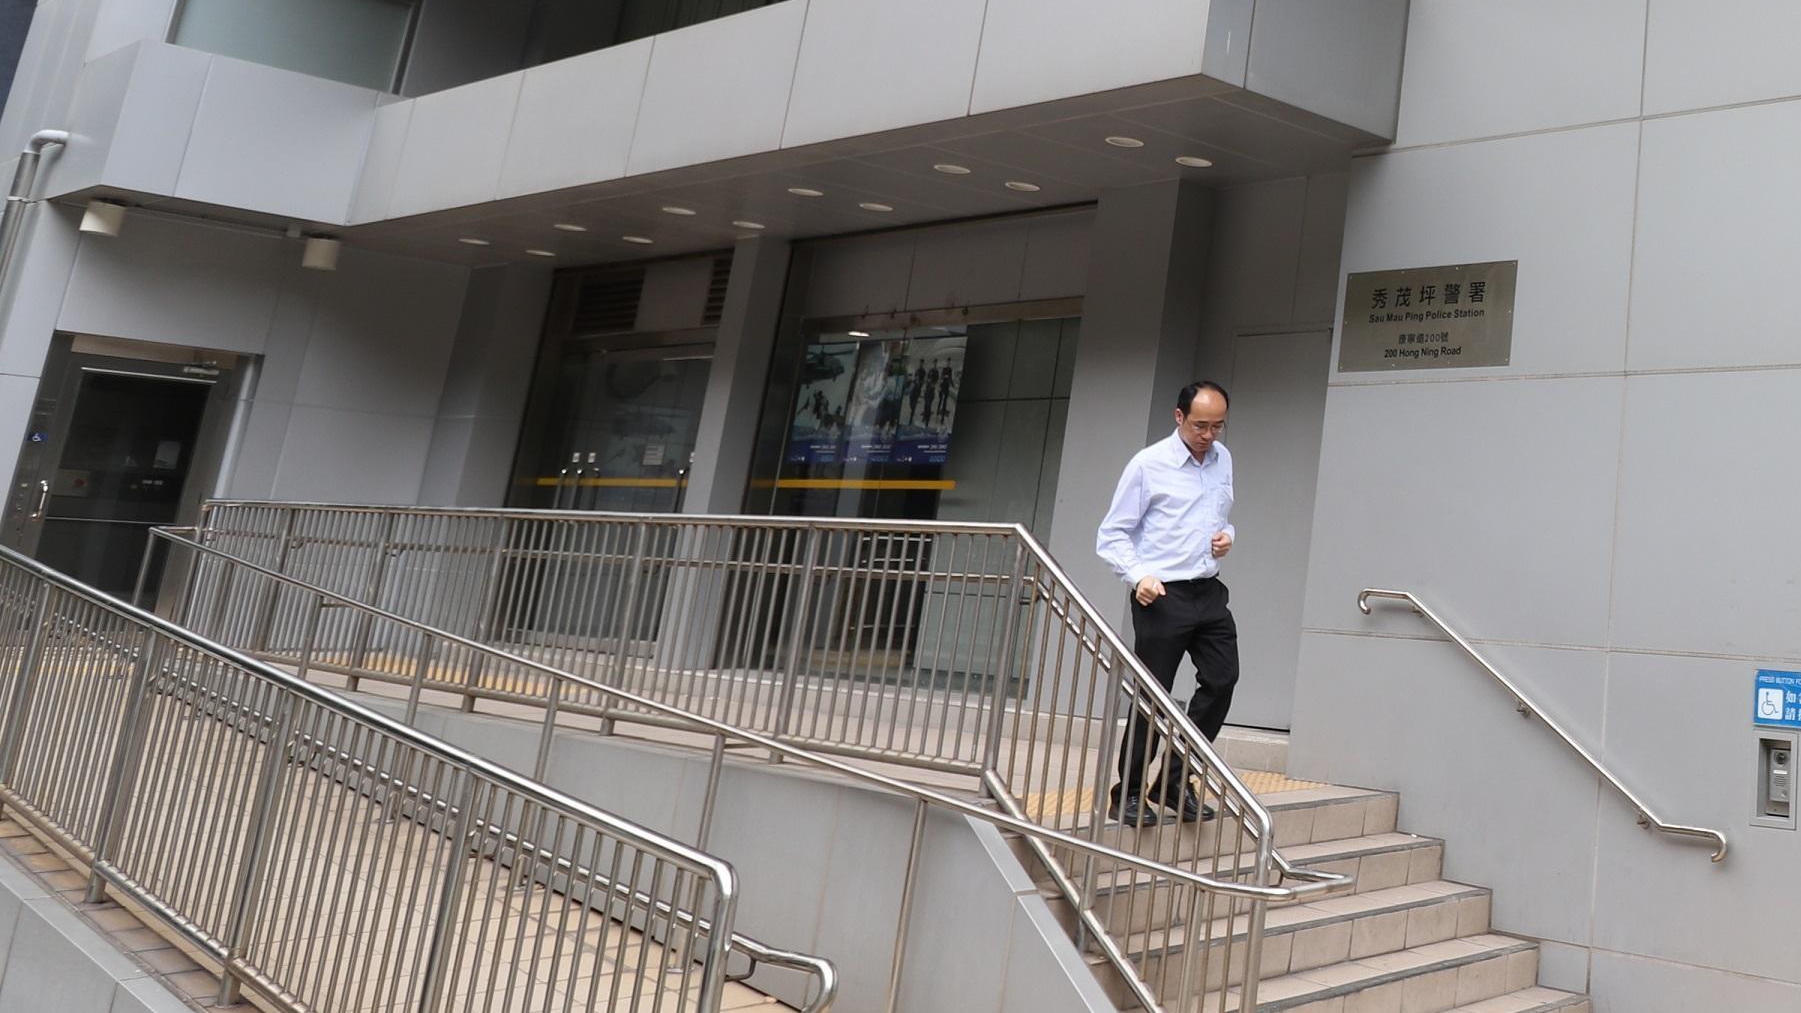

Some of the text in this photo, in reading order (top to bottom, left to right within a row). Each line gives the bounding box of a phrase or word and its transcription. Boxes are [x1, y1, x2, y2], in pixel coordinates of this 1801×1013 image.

[1371, 281, 1486, 310] 秀茂坪警署
[1369, 308, 1485, 323] Sau Mau Ping Police Station
[1384, 345, 1462, 359] 200 Hong Ning Road
